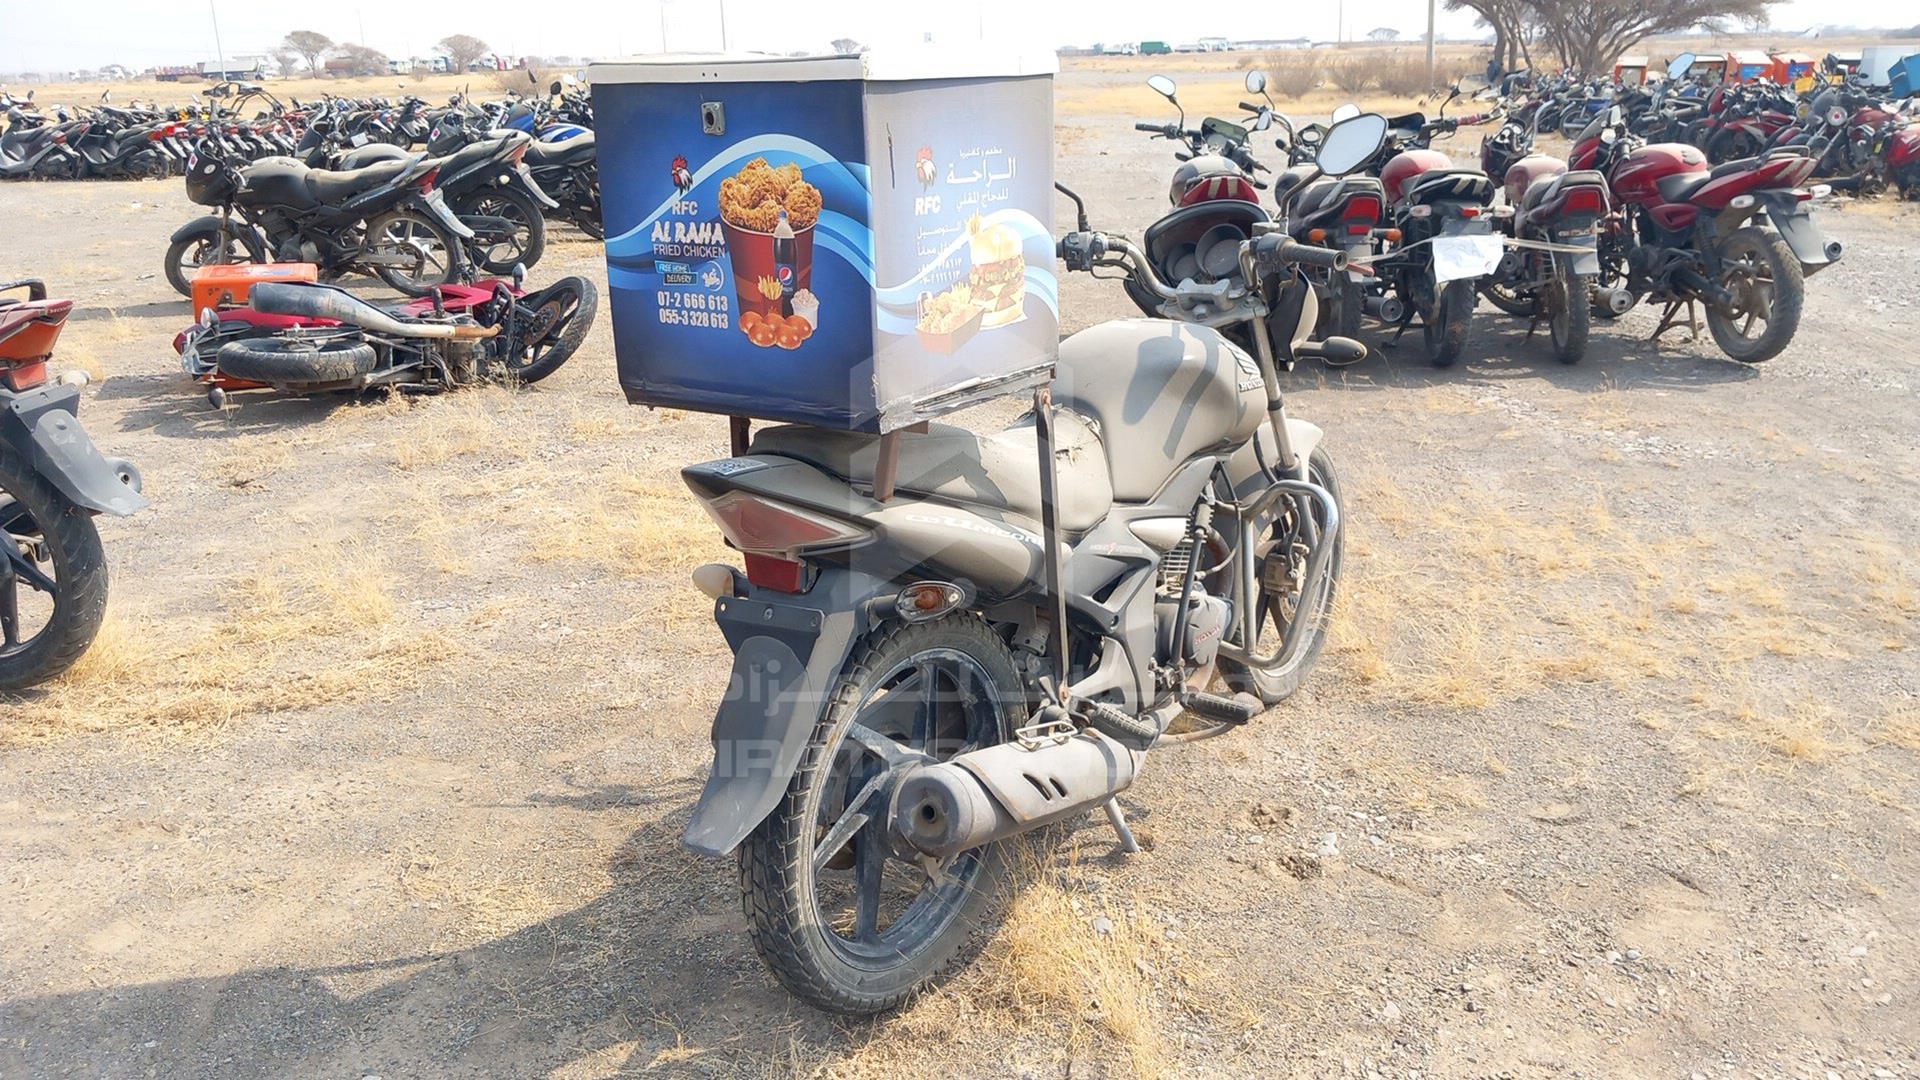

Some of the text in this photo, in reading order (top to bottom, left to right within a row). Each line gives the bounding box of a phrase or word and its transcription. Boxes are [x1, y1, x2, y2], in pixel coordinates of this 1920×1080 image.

[945, 156, 1017, 188] الراحة
[671, 200, 698, 216] RFC
[914, 195, 942, 216] RFC
[651, 220, 726, 246] AL RAHA
[653, 243, 726, 259] FRIED CHICKEN
[666, 274, 692, 284] DELIVERY
[657, 291, 729, 312] 07-2 666 613
[659, 308, 730, 329] 055-3 328 613
